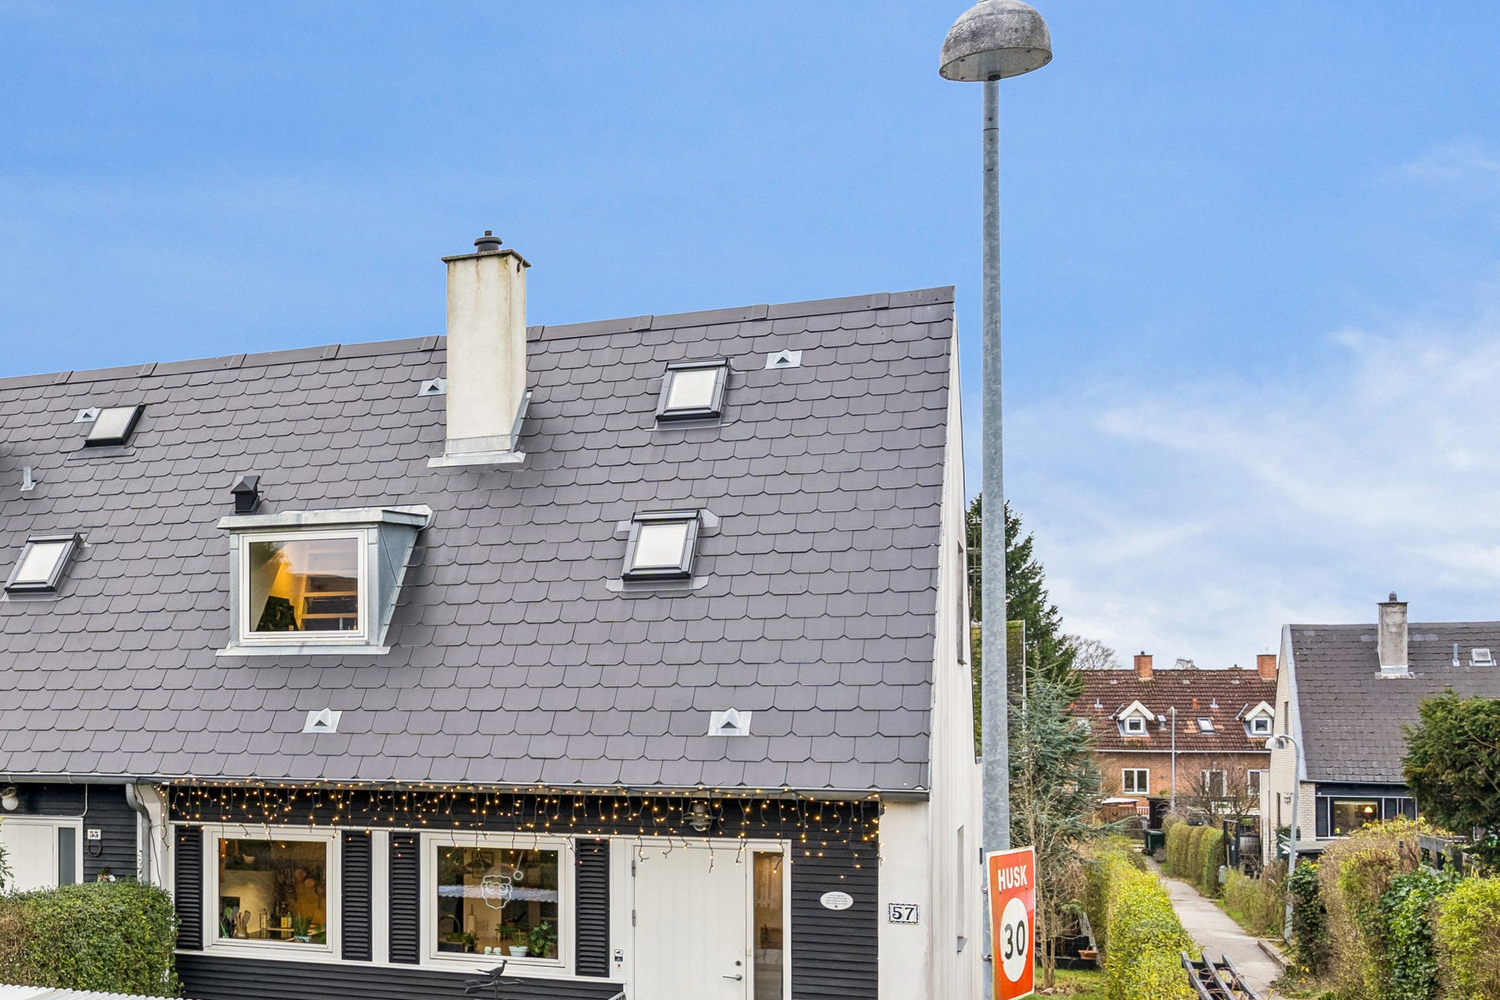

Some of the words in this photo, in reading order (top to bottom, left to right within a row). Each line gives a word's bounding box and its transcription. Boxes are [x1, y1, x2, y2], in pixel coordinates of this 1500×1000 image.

[997, 864, 1028, 892] HUSK
[892, 906, 915, 921] 57
[1004, 920, 1026, 960] 30
